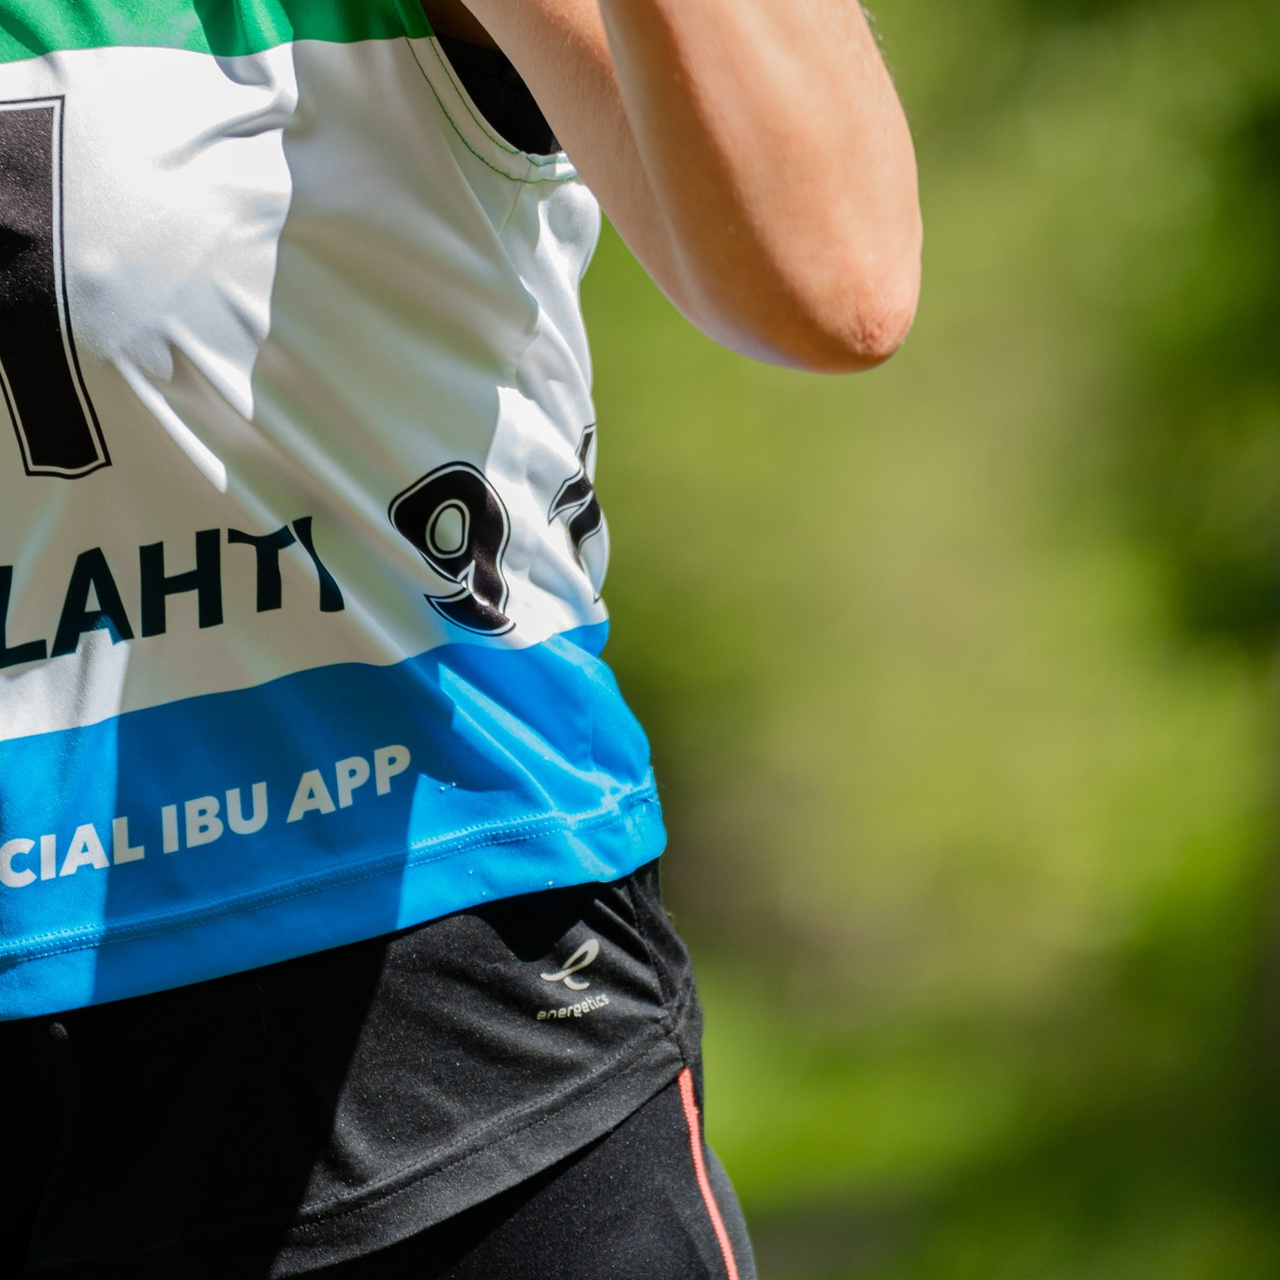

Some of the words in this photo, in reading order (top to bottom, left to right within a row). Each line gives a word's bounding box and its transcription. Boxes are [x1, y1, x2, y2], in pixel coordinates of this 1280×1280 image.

[161, 781, 269, 855] IBU
[285, 744, 412, 824] APP
[536, 994, 610, 1021] energetics
